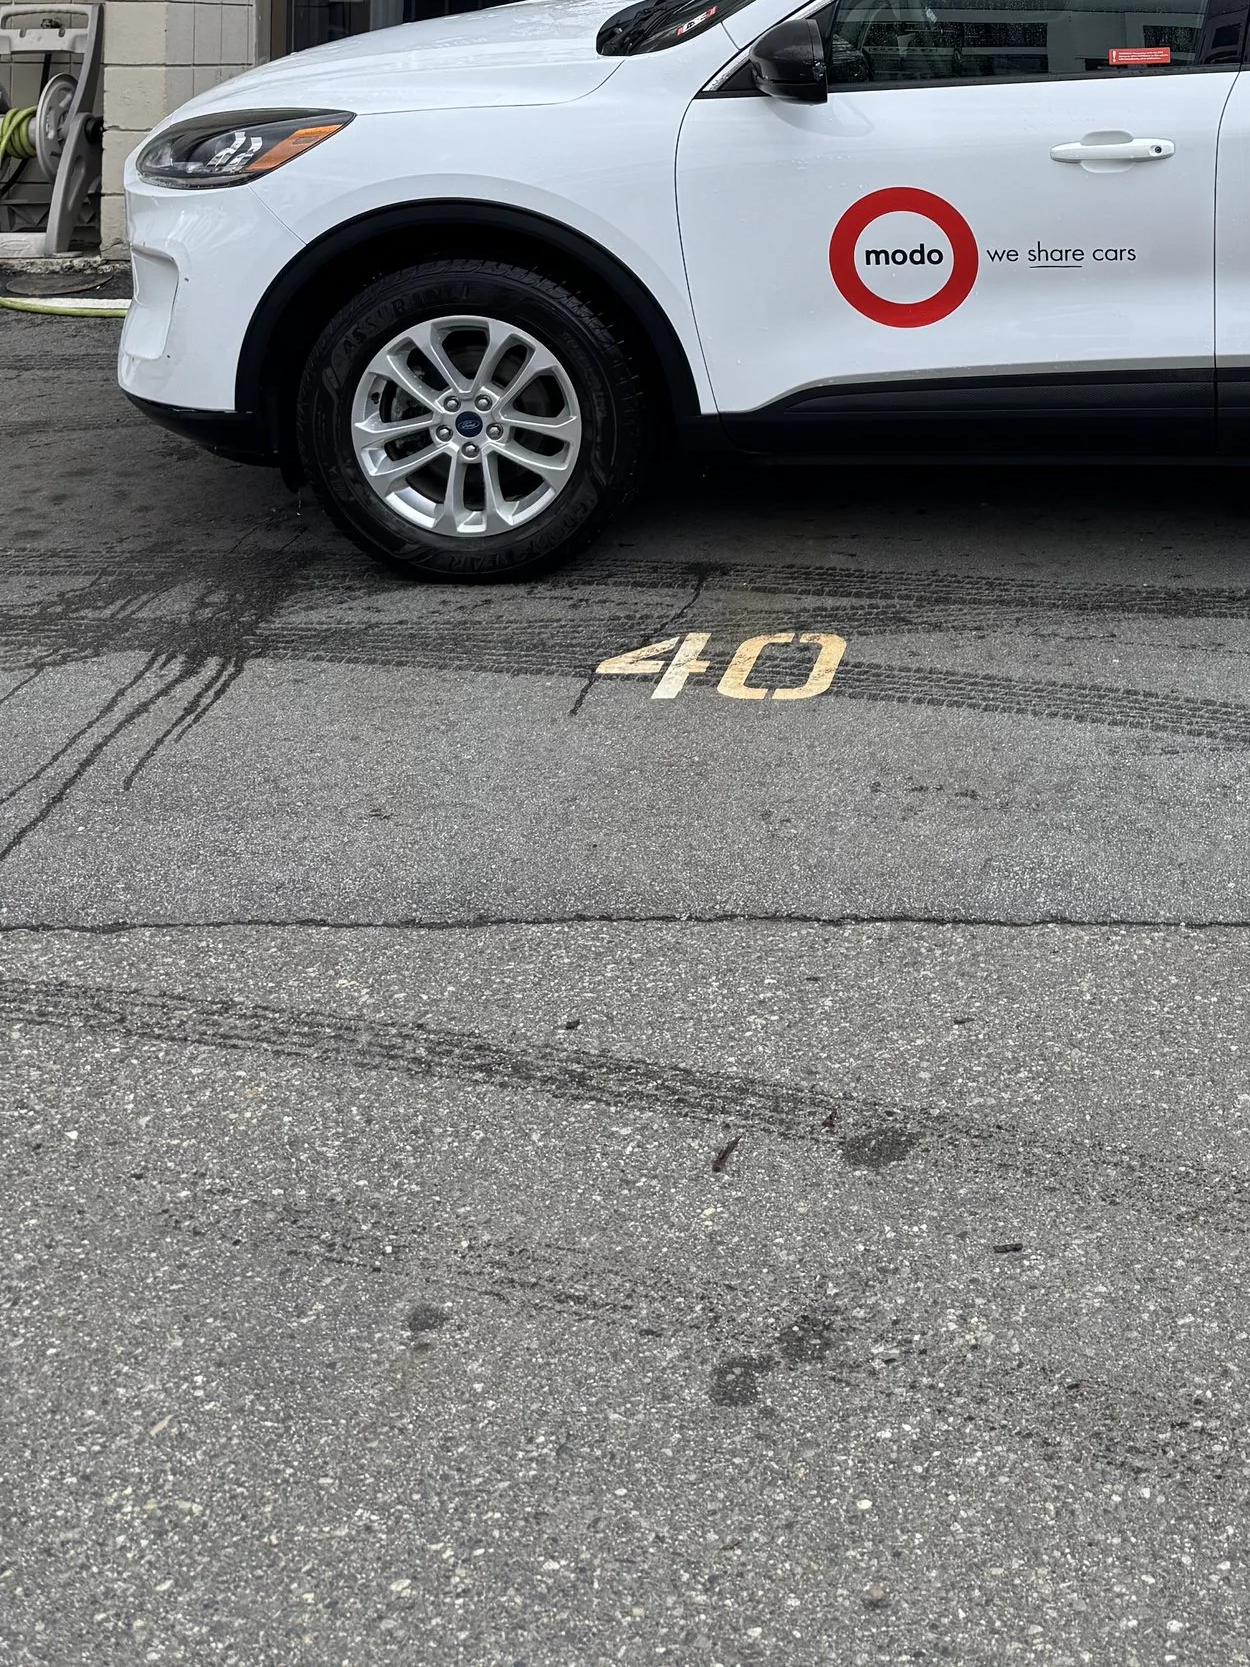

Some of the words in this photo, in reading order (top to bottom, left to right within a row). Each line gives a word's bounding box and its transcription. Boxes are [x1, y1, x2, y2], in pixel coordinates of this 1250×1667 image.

[865, 243, 944, 266] modo
[986, 247, 1019, 262] we
[1028, 241, 1085, 263] share
[1092, 246, 1137, 262] cars
[595, 632, 847, 699] 40
